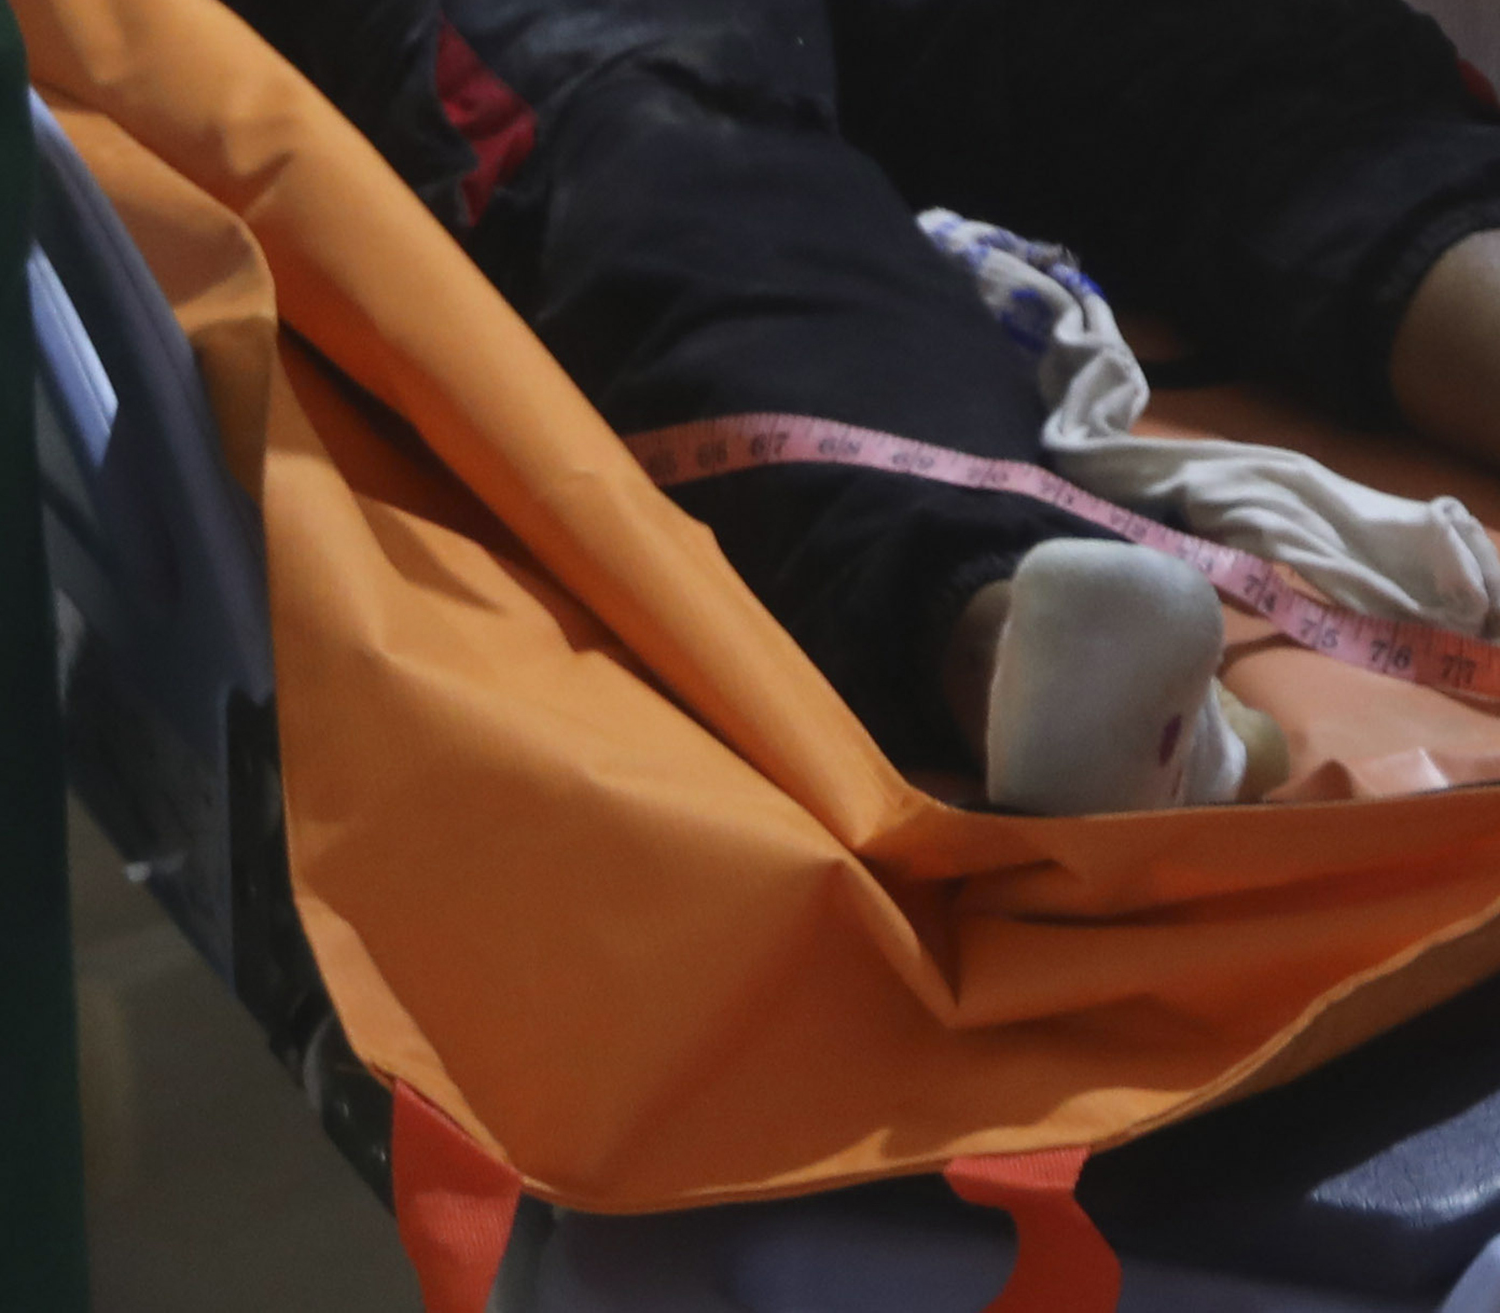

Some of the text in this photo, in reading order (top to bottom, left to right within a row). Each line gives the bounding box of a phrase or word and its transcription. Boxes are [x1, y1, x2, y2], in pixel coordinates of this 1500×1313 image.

[750, 431, 790, 458] 67
[1300, 618, 1340, 649] 75
[1369, 638, 1413, 671] 76
